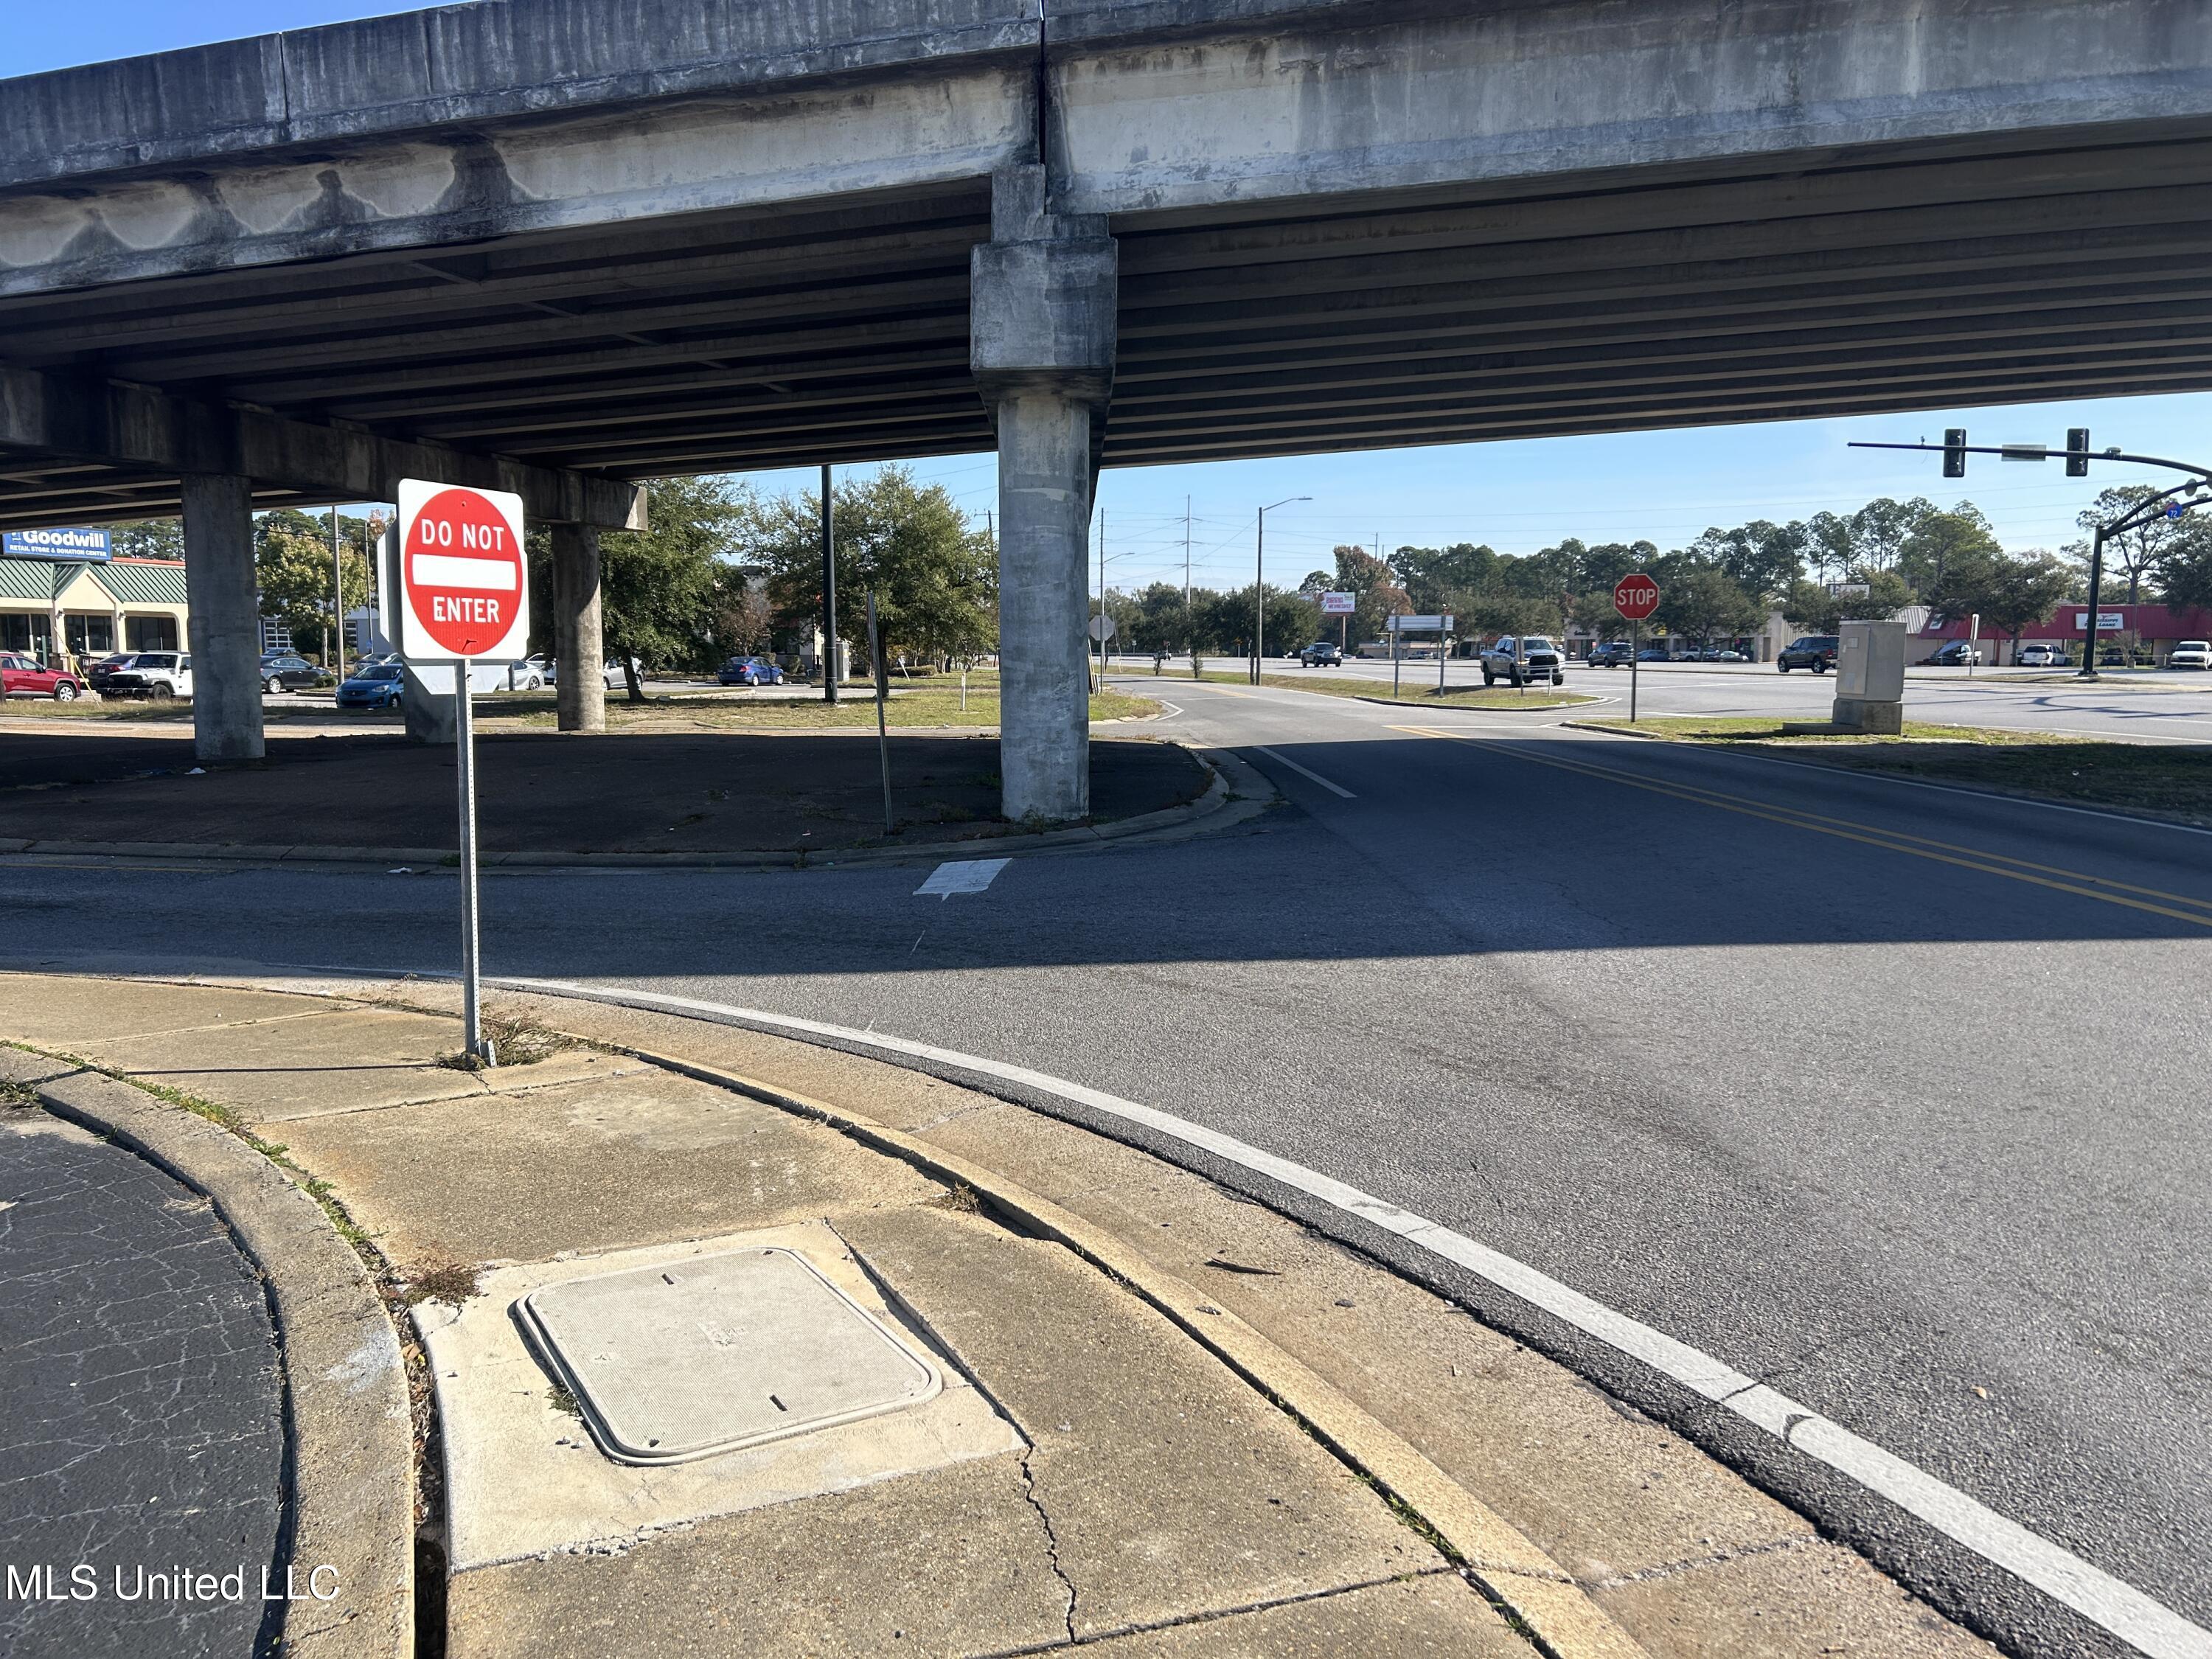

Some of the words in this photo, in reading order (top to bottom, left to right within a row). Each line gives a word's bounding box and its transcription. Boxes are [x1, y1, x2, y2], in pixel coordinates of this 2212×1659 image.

[23, 530, 105, 548] Goodwill
[421, 518, 452, 546] DO
[462, 523, 504, 551] NOT
[1617, 588, 1656, 605] STOP
[433, 596, 500, 623] ENTER
